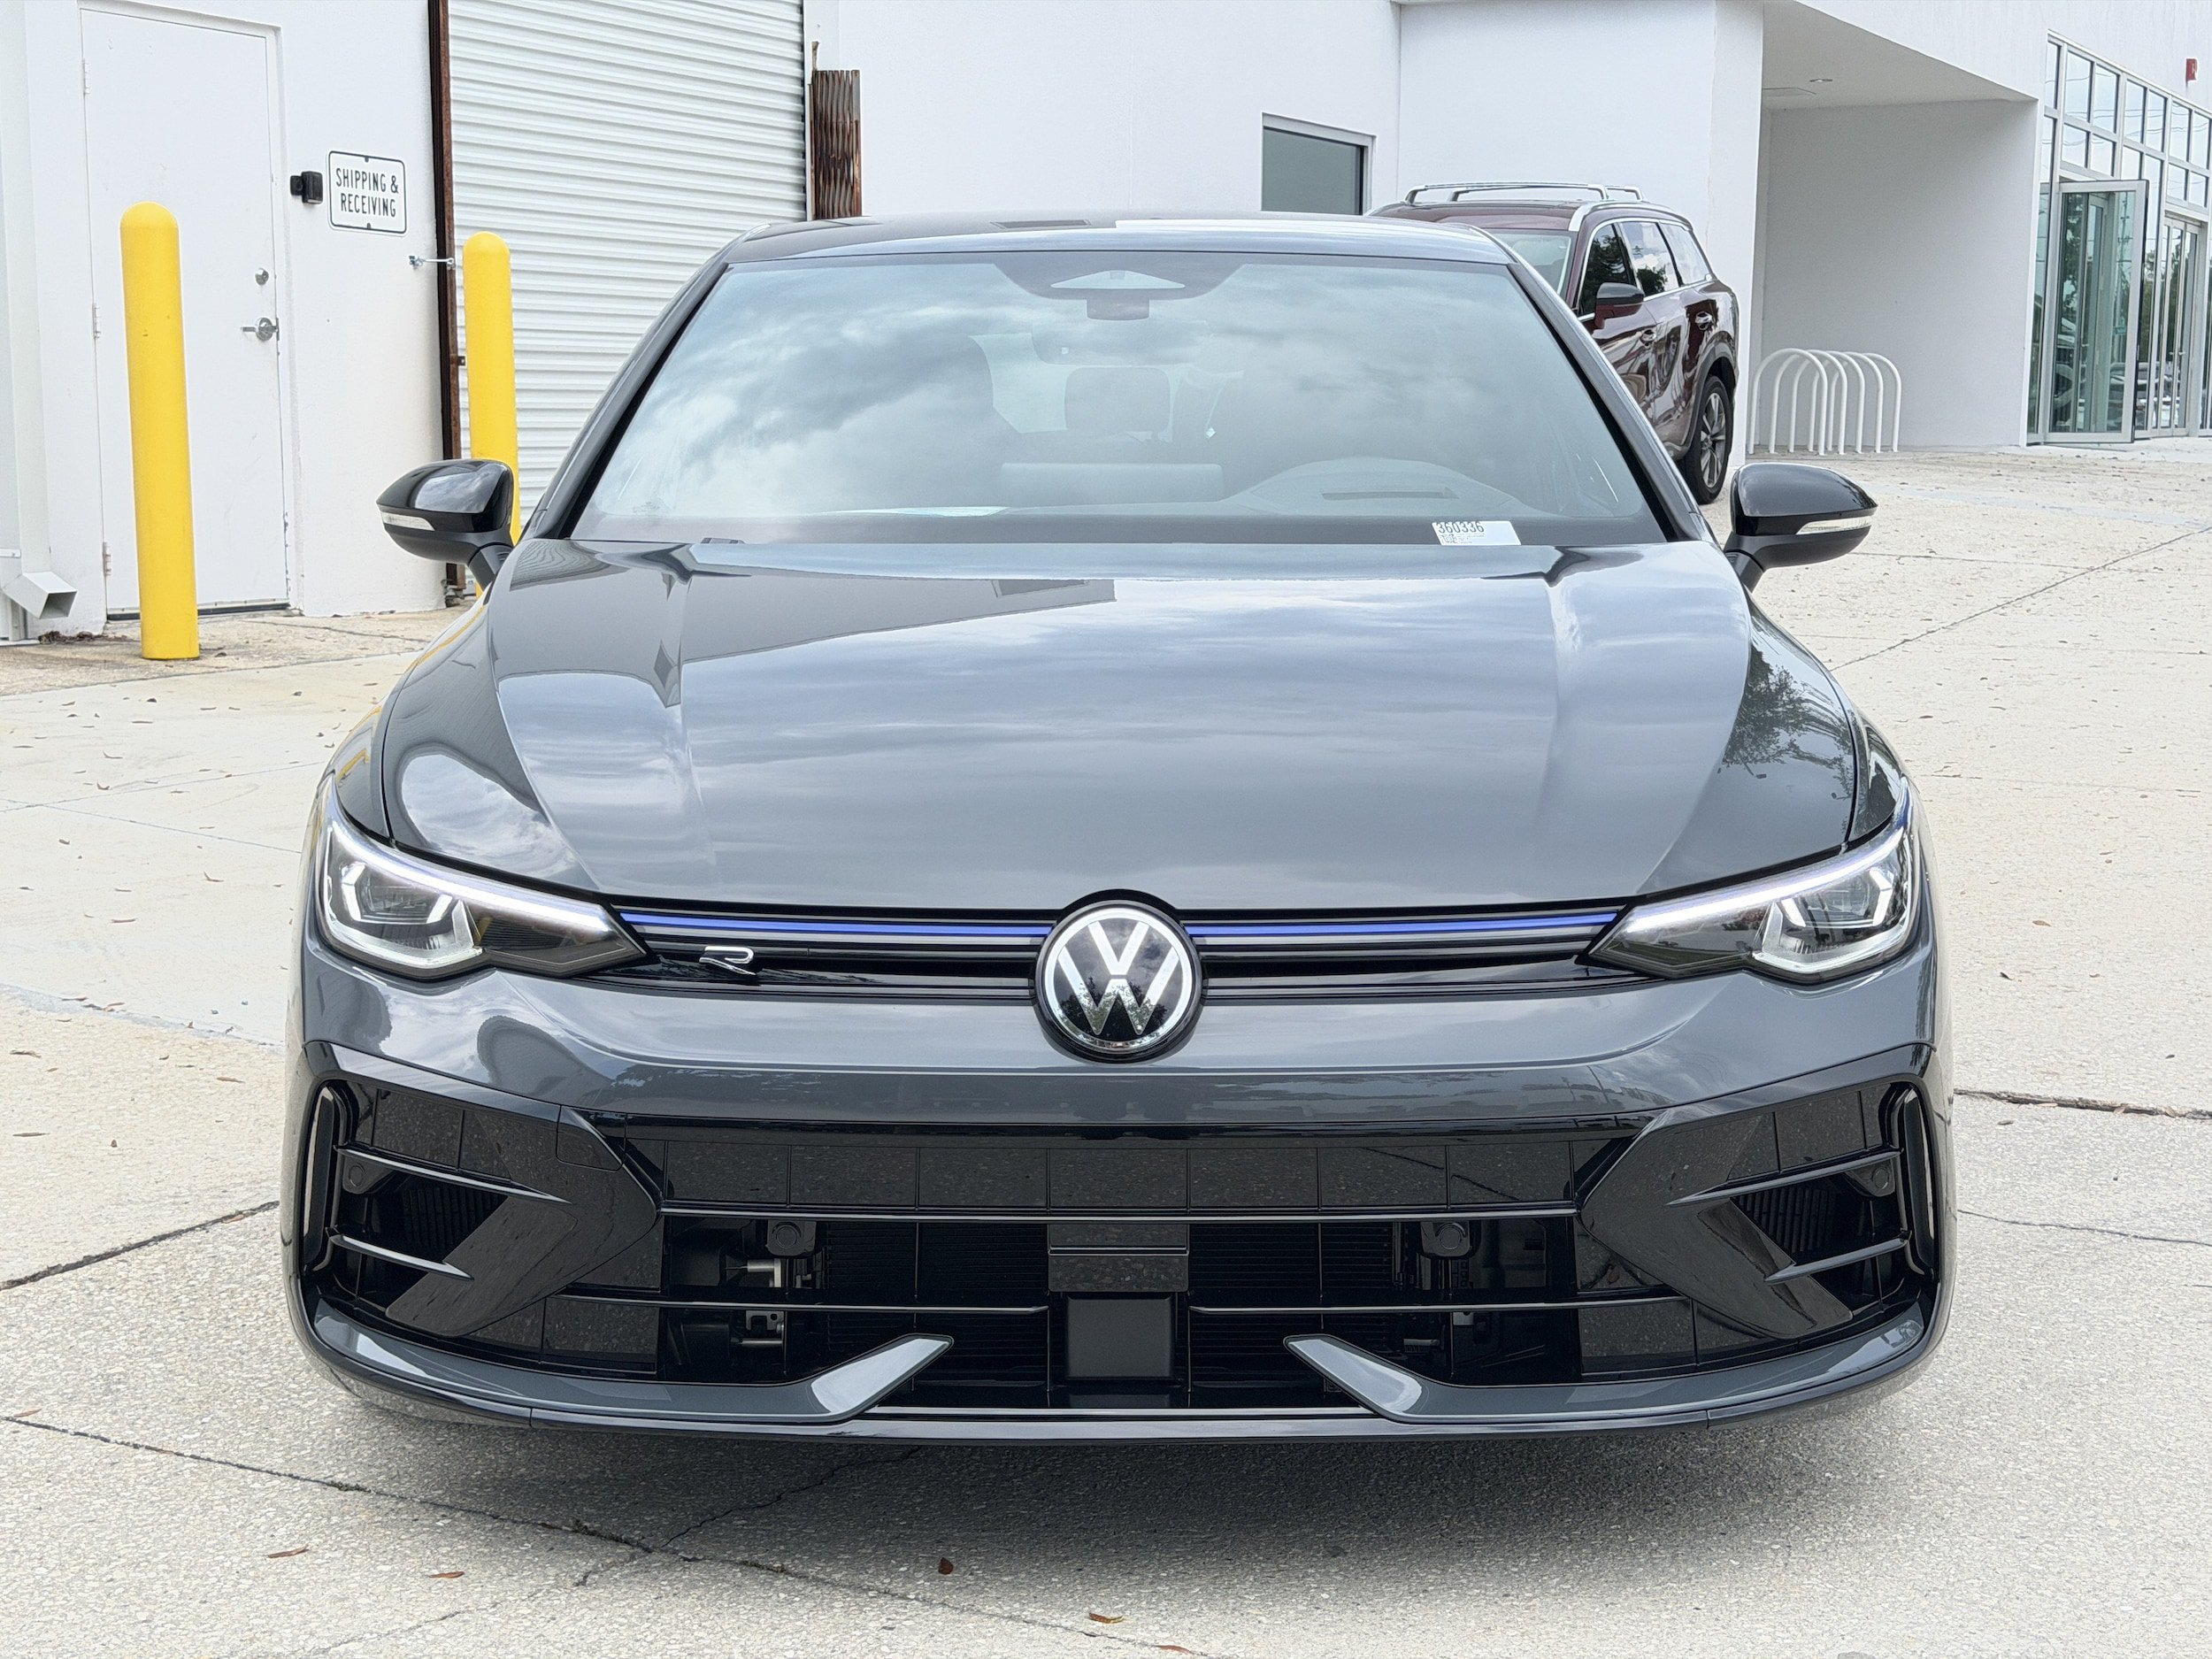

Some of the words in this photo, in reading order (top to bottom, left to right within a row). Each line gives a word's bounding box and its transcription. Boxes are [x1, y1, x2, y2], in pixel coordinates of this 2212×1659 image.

[336, 167, 387, 192] SHIPPING
[390, 175, 399, 194] &
[341, 192, 396, 218] RECEIVING
[1436, 520, 1485, 534] 360336
[699, 946, 757, 976] R
[1056, 920, 1180, 1036] VW
